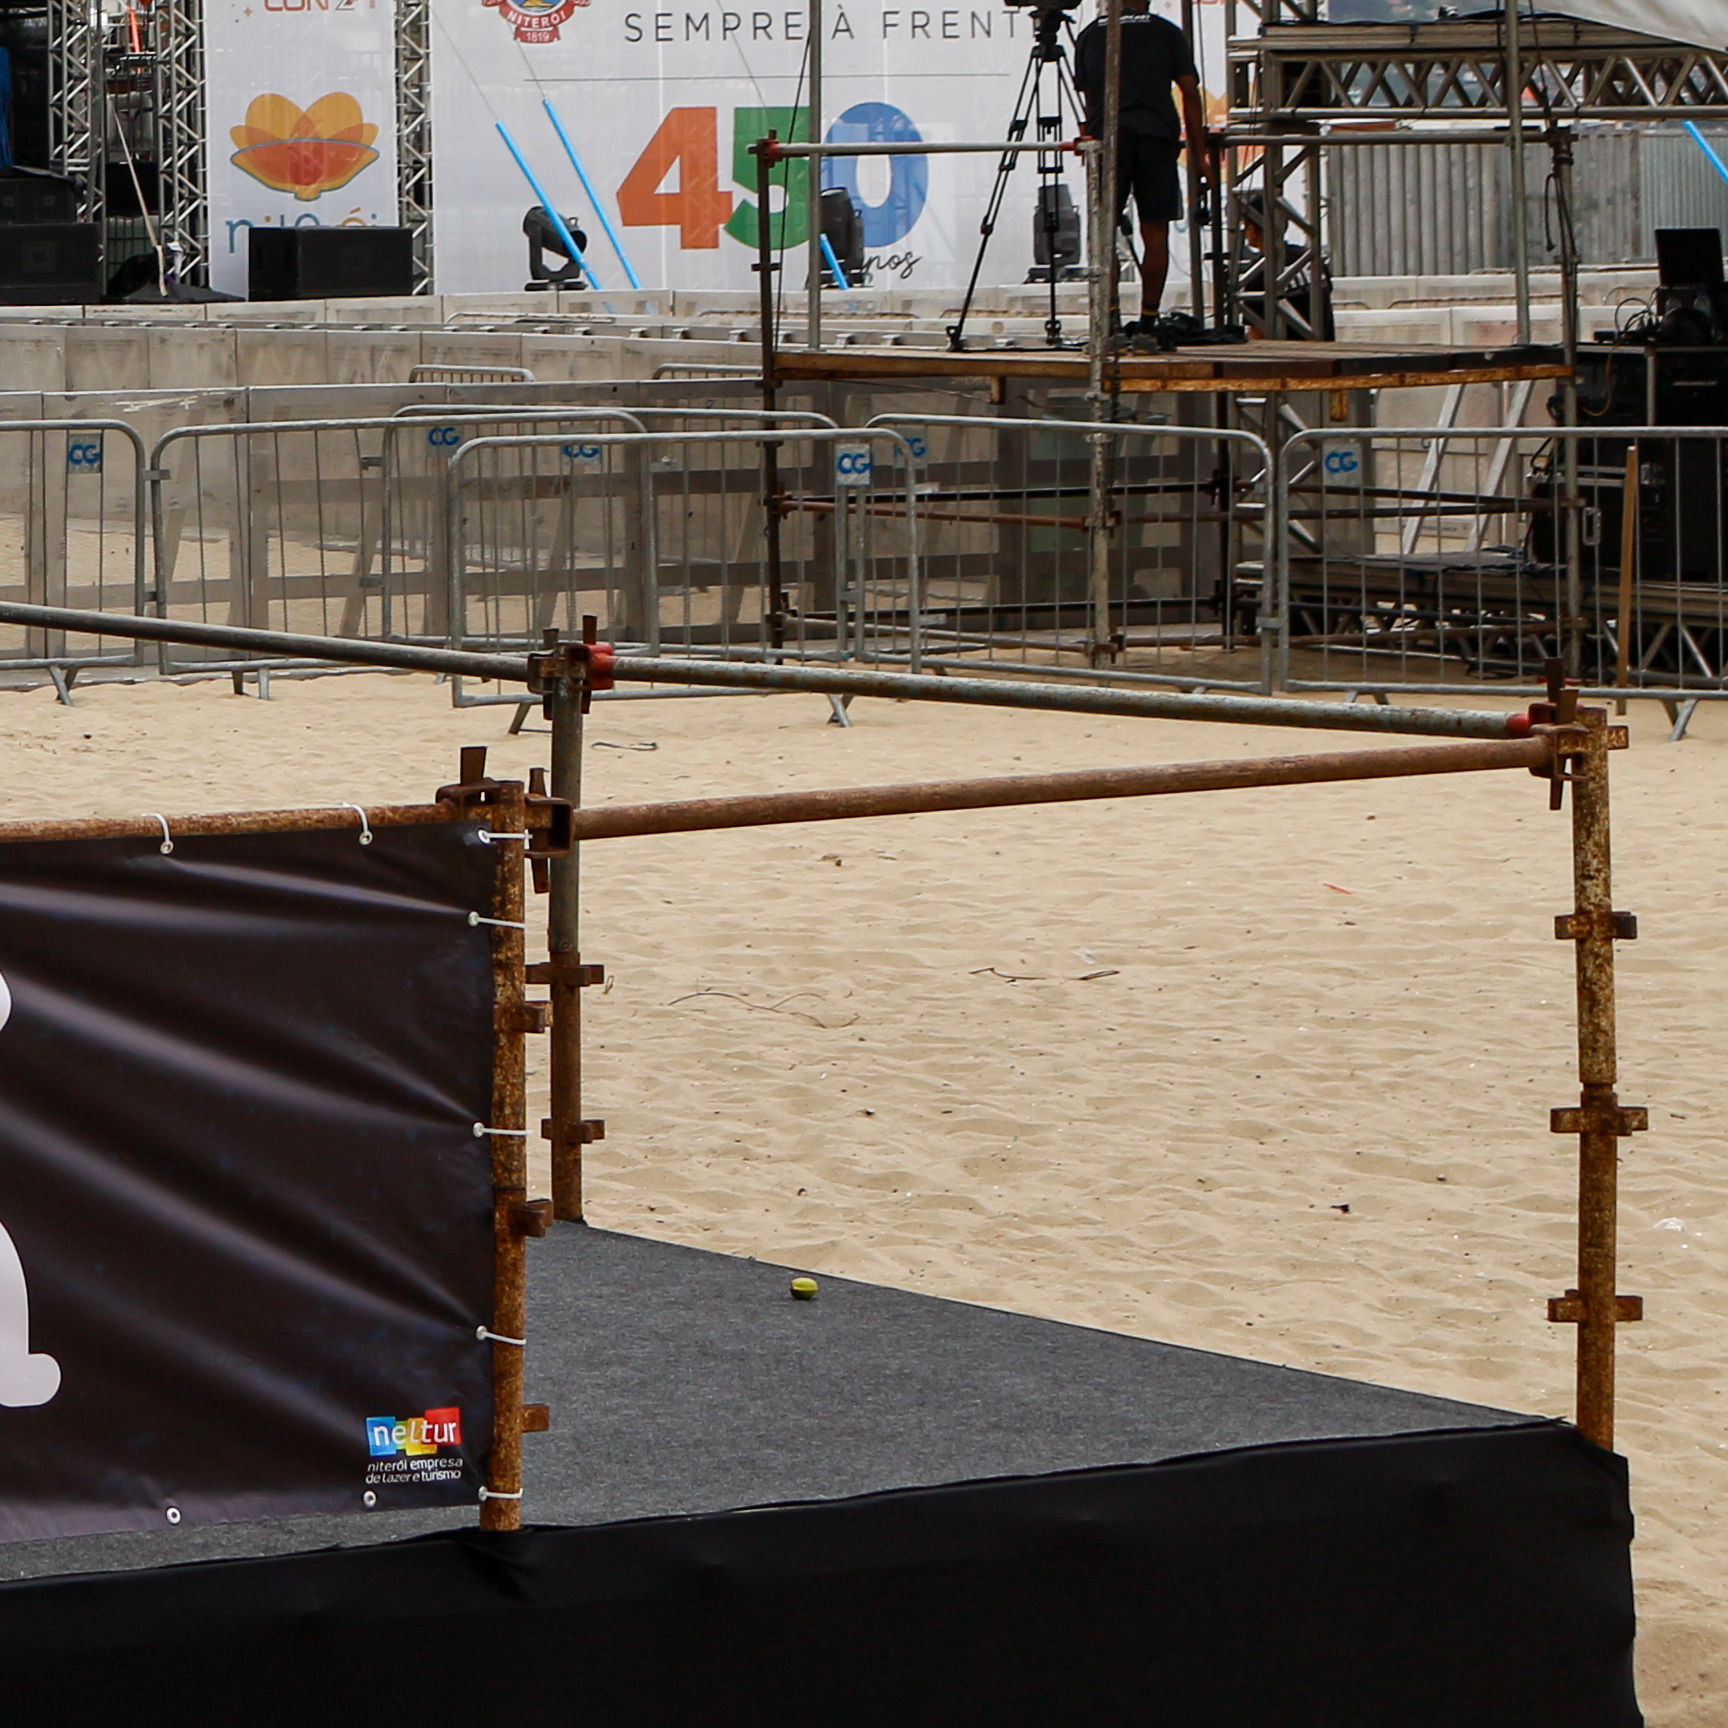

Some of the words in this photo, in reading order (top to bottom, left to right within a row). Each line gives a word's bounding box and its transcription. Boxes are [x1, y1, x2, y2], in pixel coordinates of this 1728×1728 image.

[508, 10, 566, 28] NITERÓI
[625, 10, 805, 43] SEMPRE
[831, 2, 856, 39] À
[883, 9, 1019, 40] FRENT
[616, 101, 929, 250] 450
[429, 427, 460, 446] CG
[69, 443, 102, 465] CG
[837, 453, 873, 474] CG
[1325, 451, 1358, 473] CG
[374, 1419, 457, 1446] neltur
[367, 1459, 407, 1472] niterói
[410, 1458, 464, 1472] empresa
[365, 1473, 381, 1485] de
[382, 1472, 410, 1484] lazer
[413, 1474, 421, 1482] e
[421, 1469, 461, 1482] turismo
